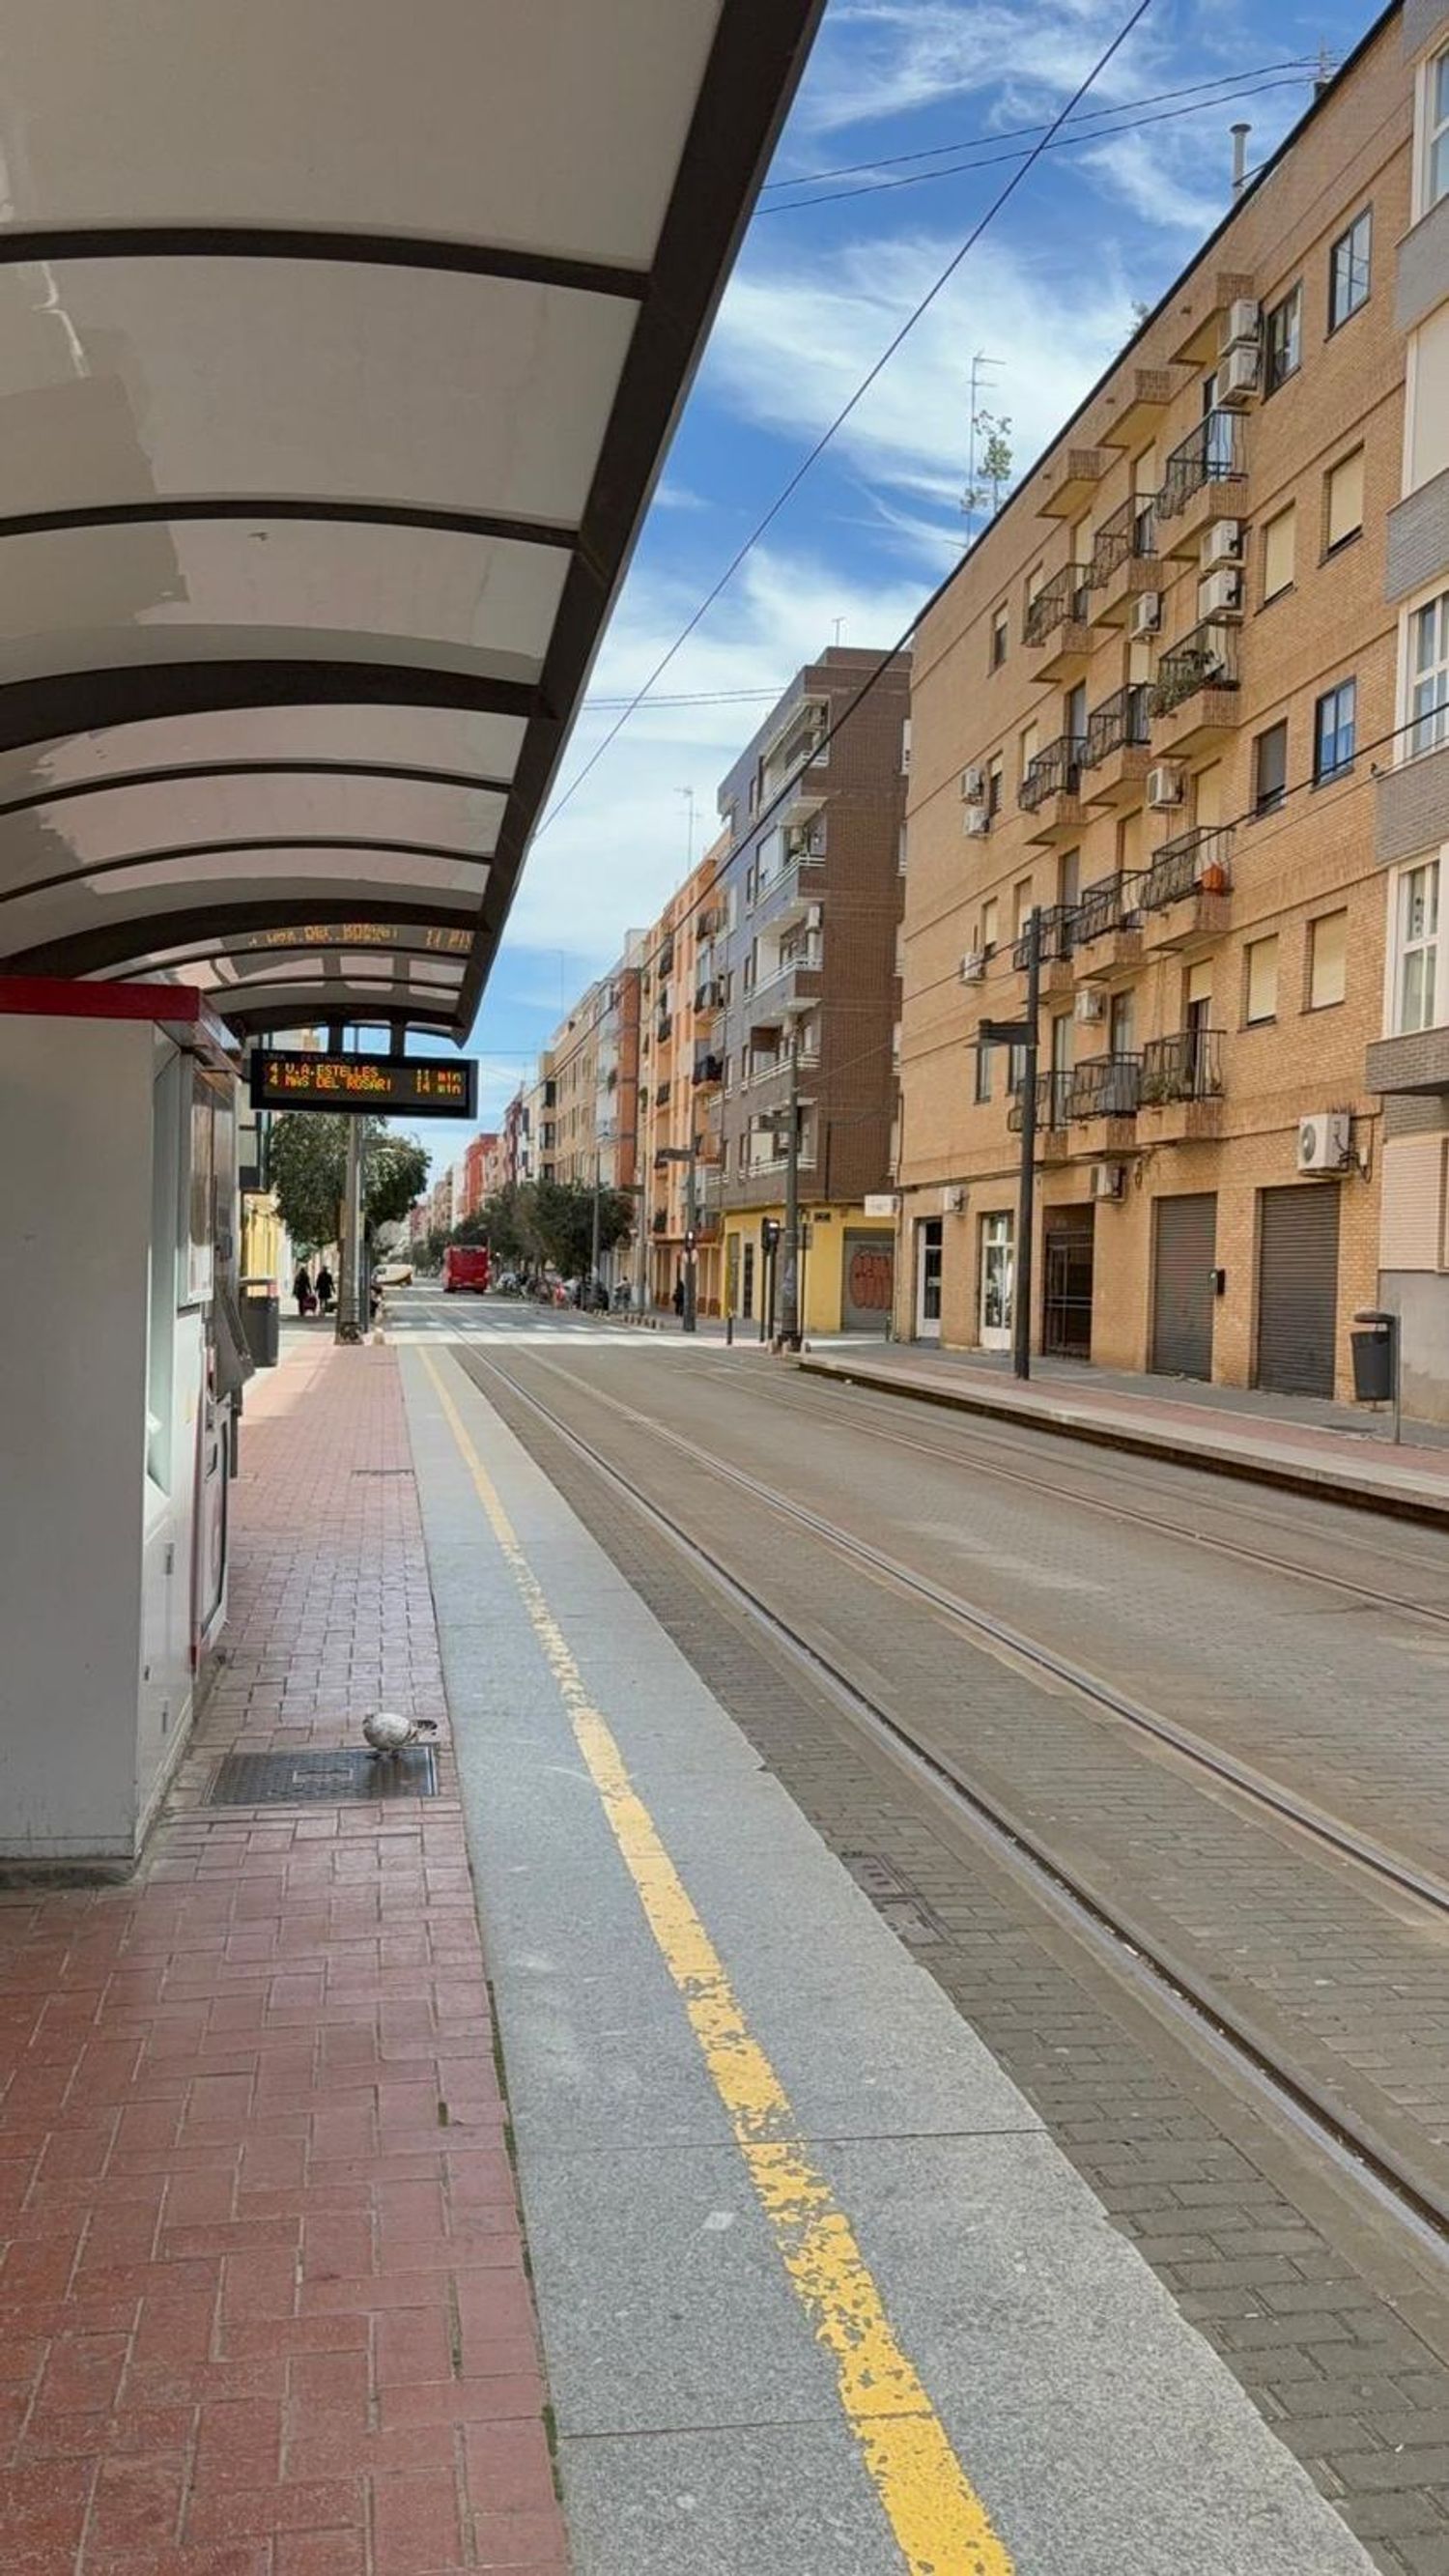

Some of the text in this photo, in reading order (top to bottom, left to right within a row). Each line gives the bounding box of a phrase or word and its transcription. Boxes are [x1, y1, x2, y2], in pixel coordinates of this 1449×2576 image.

[270, 1063, 278, 1073] 4
[270, 1074, 278, 1085] 4
[316, 1076, 341, 1089] DEL
